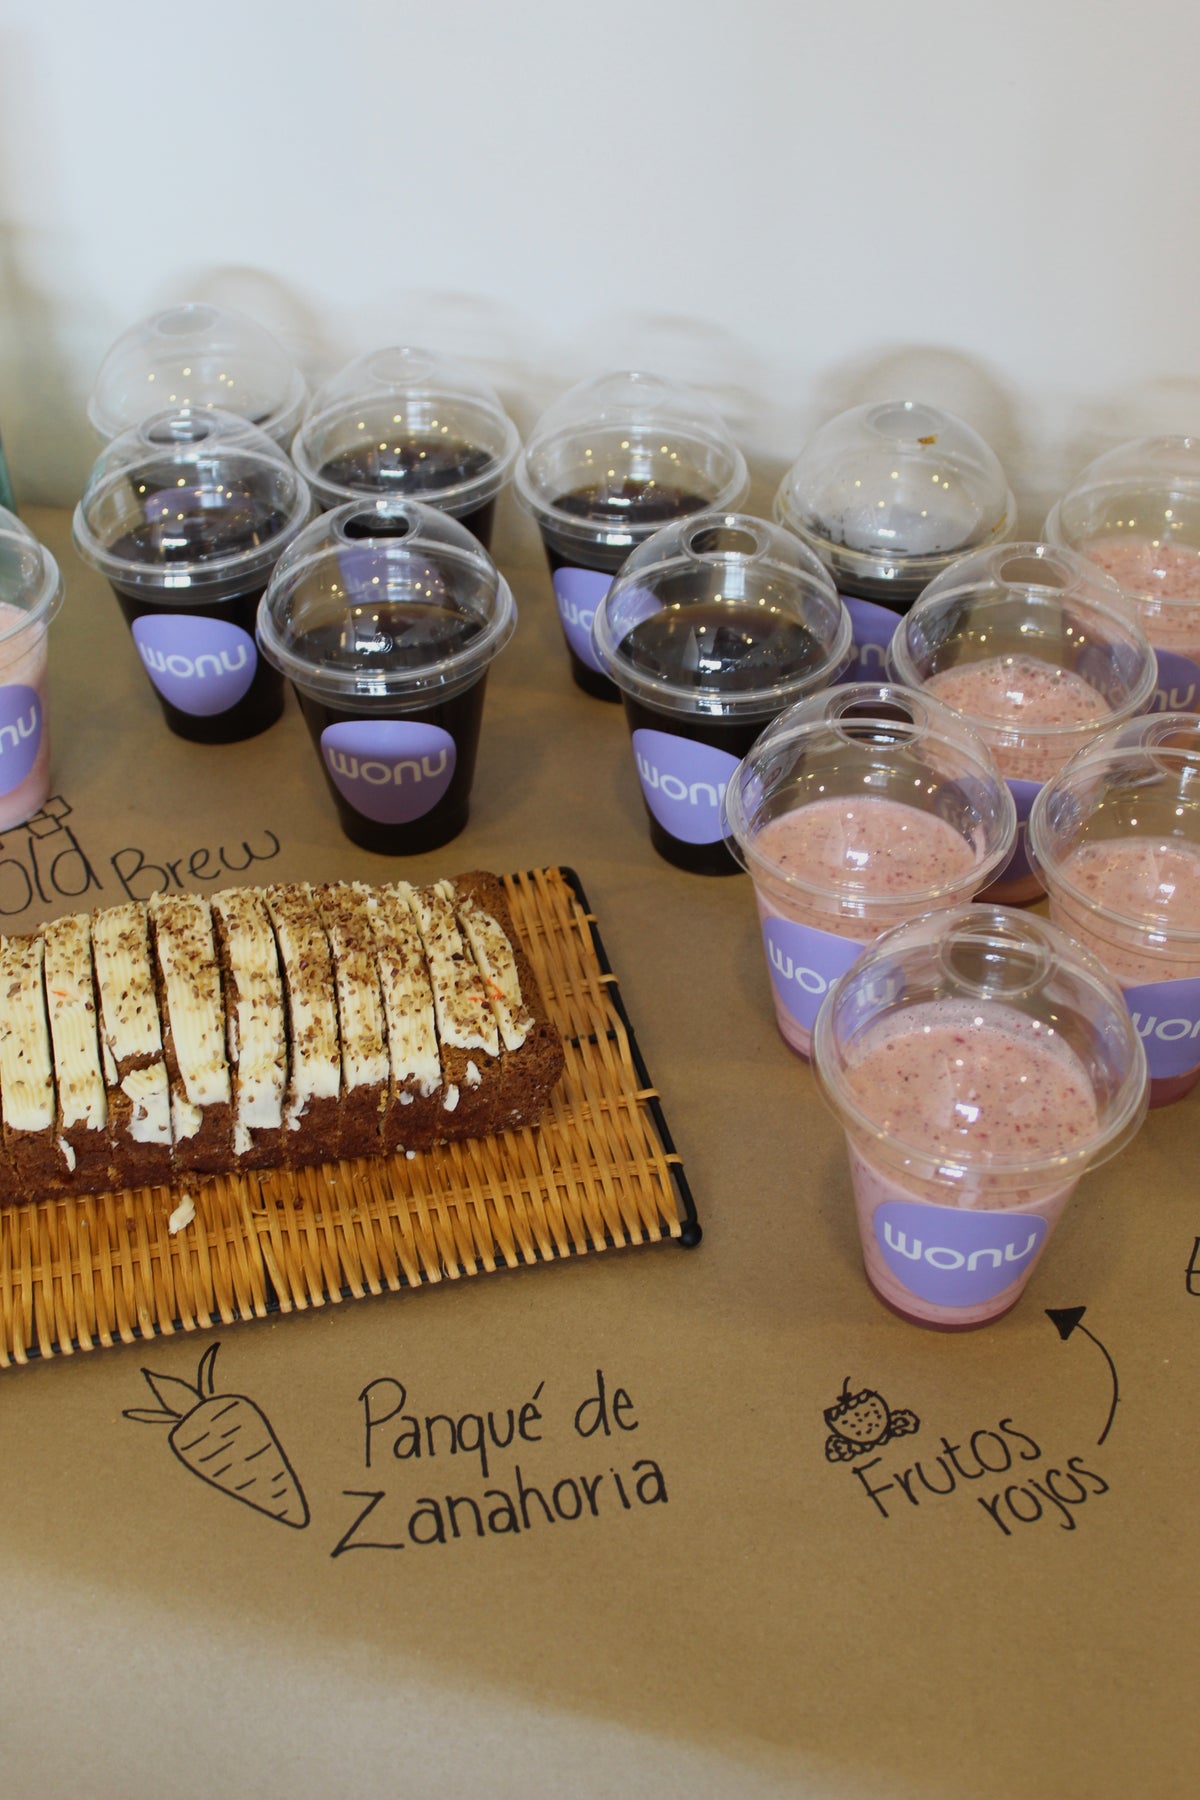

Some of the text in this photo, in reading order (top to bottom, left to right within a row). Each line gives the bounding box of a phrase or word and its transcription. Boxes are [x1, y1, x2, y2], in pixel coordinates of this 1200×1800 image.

[139, 641, 248, 679] wonu
[0, 704, 38, 756] nu
[328, 747, 449, 785] wonu
[0, 825, 281, 916] old Brew
[883, 1221, 1037, 1271] wonu
[358, 1368, 639, 1478] Panqué de
[851, 1417, 1043, 1518] Frutos
[977, 1454, 1110, 1536] rojos
[330, 1459, 669, 1559] Zanahoria
